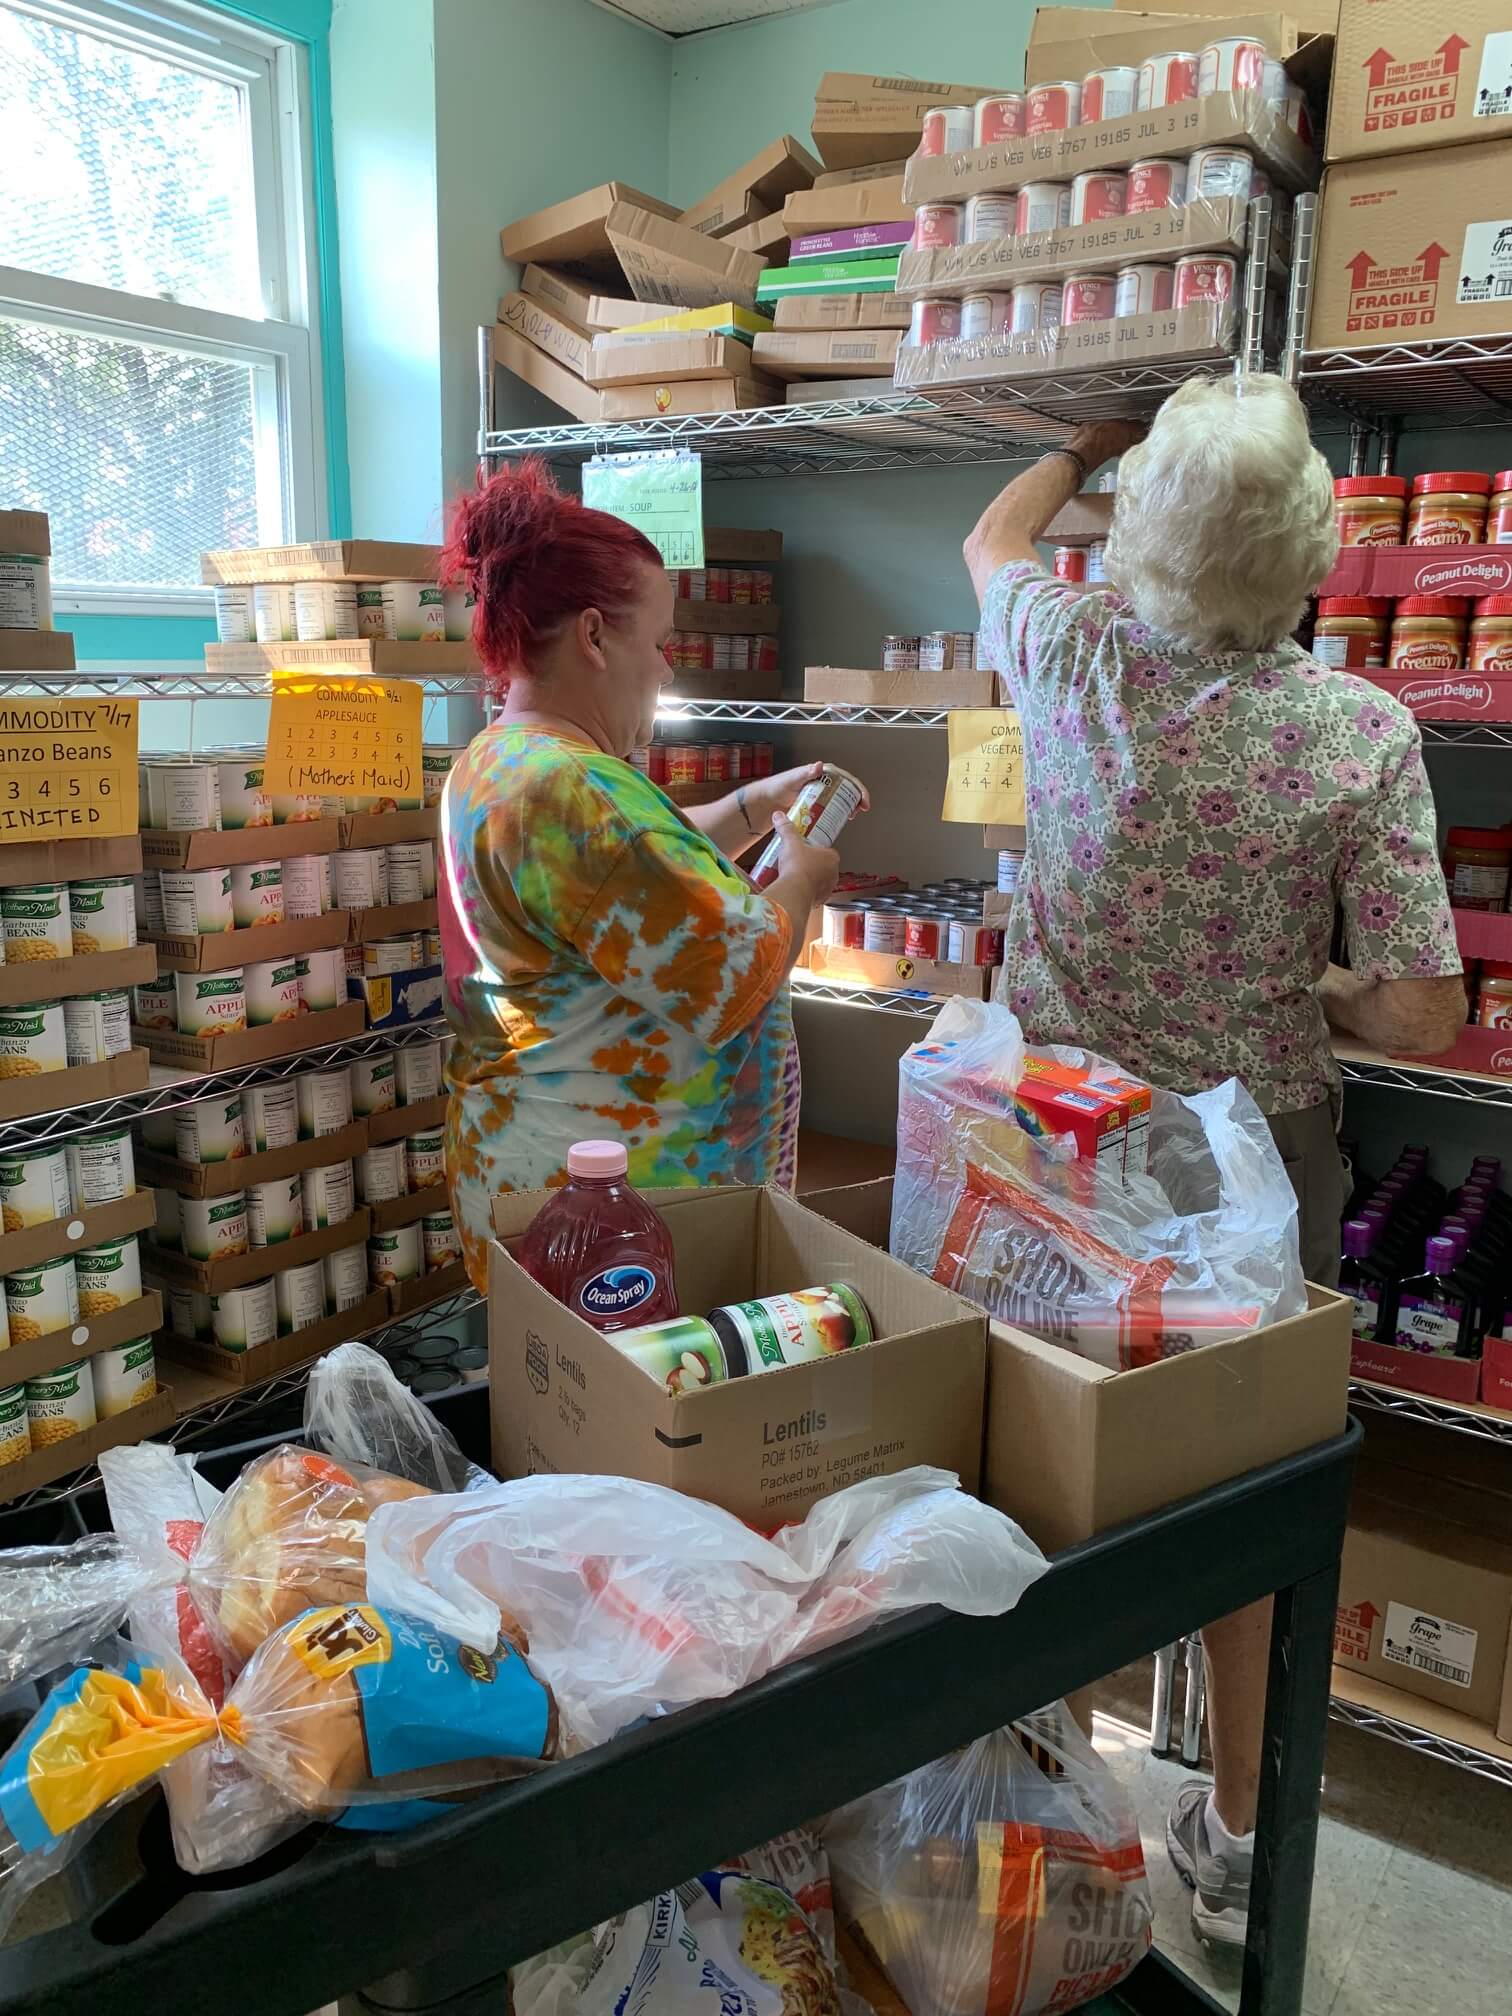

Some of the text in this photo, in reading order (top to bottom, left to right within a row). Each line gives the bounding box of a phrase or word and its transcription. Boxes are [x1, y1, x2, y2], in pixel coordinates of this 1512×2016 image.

[1387, 58, 1443, 76] THIS SIDE UP
[1373, 83, 1450, 108] FRAGILE
[1057, 138, 1087, 155] 3767
[1093, 127, 1131, 147] 19185
[1137, 123, 1160, 139] JUL
[1167, 118, 1176, 132] 3
[1183, 113, 1199, 129] 19
[1082, 231, 1117, 248] 19185
[1123, 227, 1145, 242] JUL
[1153, 223, 1161, 236] 3
[1169, 219, 1184, 233] 19
[1369, 265, 1423, 280] THIS SIDE UP
[1356, 290, 1430, 309] FRAGILE
[1076, 333, 1111, 348] 19185
[1117, 328, 1139, 343] JUL
[1146, 325, 1155, 339] 3
[1161, 321, 1177, 335] 19
[630, 502, 653, 512] SOUP
[1422, 564, 1504, 587] Peanut Delight
[316, 689, 379, 704] COMMODITY
[1405, 683, 1484, 703] Peanut Delight
[315, 709, 377, 723] APPLESAUCE
[287, 728, 403, 743] 1 2 3 4 5 6
[53, 743, 111, 760] Beans
[286, 745, 293, 758] 2
[307, 748, 316, 757] 2
[330, 747, 336, 758] 3
[352, 748, 358, 759] 3
[371, 751, 379, 760] 4
[966, 762, 1012, 773] 1 2 3
[8, 778, 110, 799] 3 4 5 6
[962, 777, 1012, 788] 4 4 4
[7, 928, 46, 937] BEANS
[588, 1280, 645, 1305] Ocean Spray
[984, 1277, 1079, 1343] ONLINE
[556, 1343, 586, 1390] Lentils
[558, 1385, 563, 1399] 2
[573, 1420, 580, 1436] 12
[763, 1410, 827, 1445] Lentils
[762, 1440, 820, 1468] PO# 15762
[760, 1471, 803, 1490] Packed
[826, 1450, 870, 1472] Legume
[873, 1440, 905, 1458] Matrix
[761, 1462, 886, 1509] Jamestown, ND 58401
[1409, 1622, 1442, 1642] Grape
